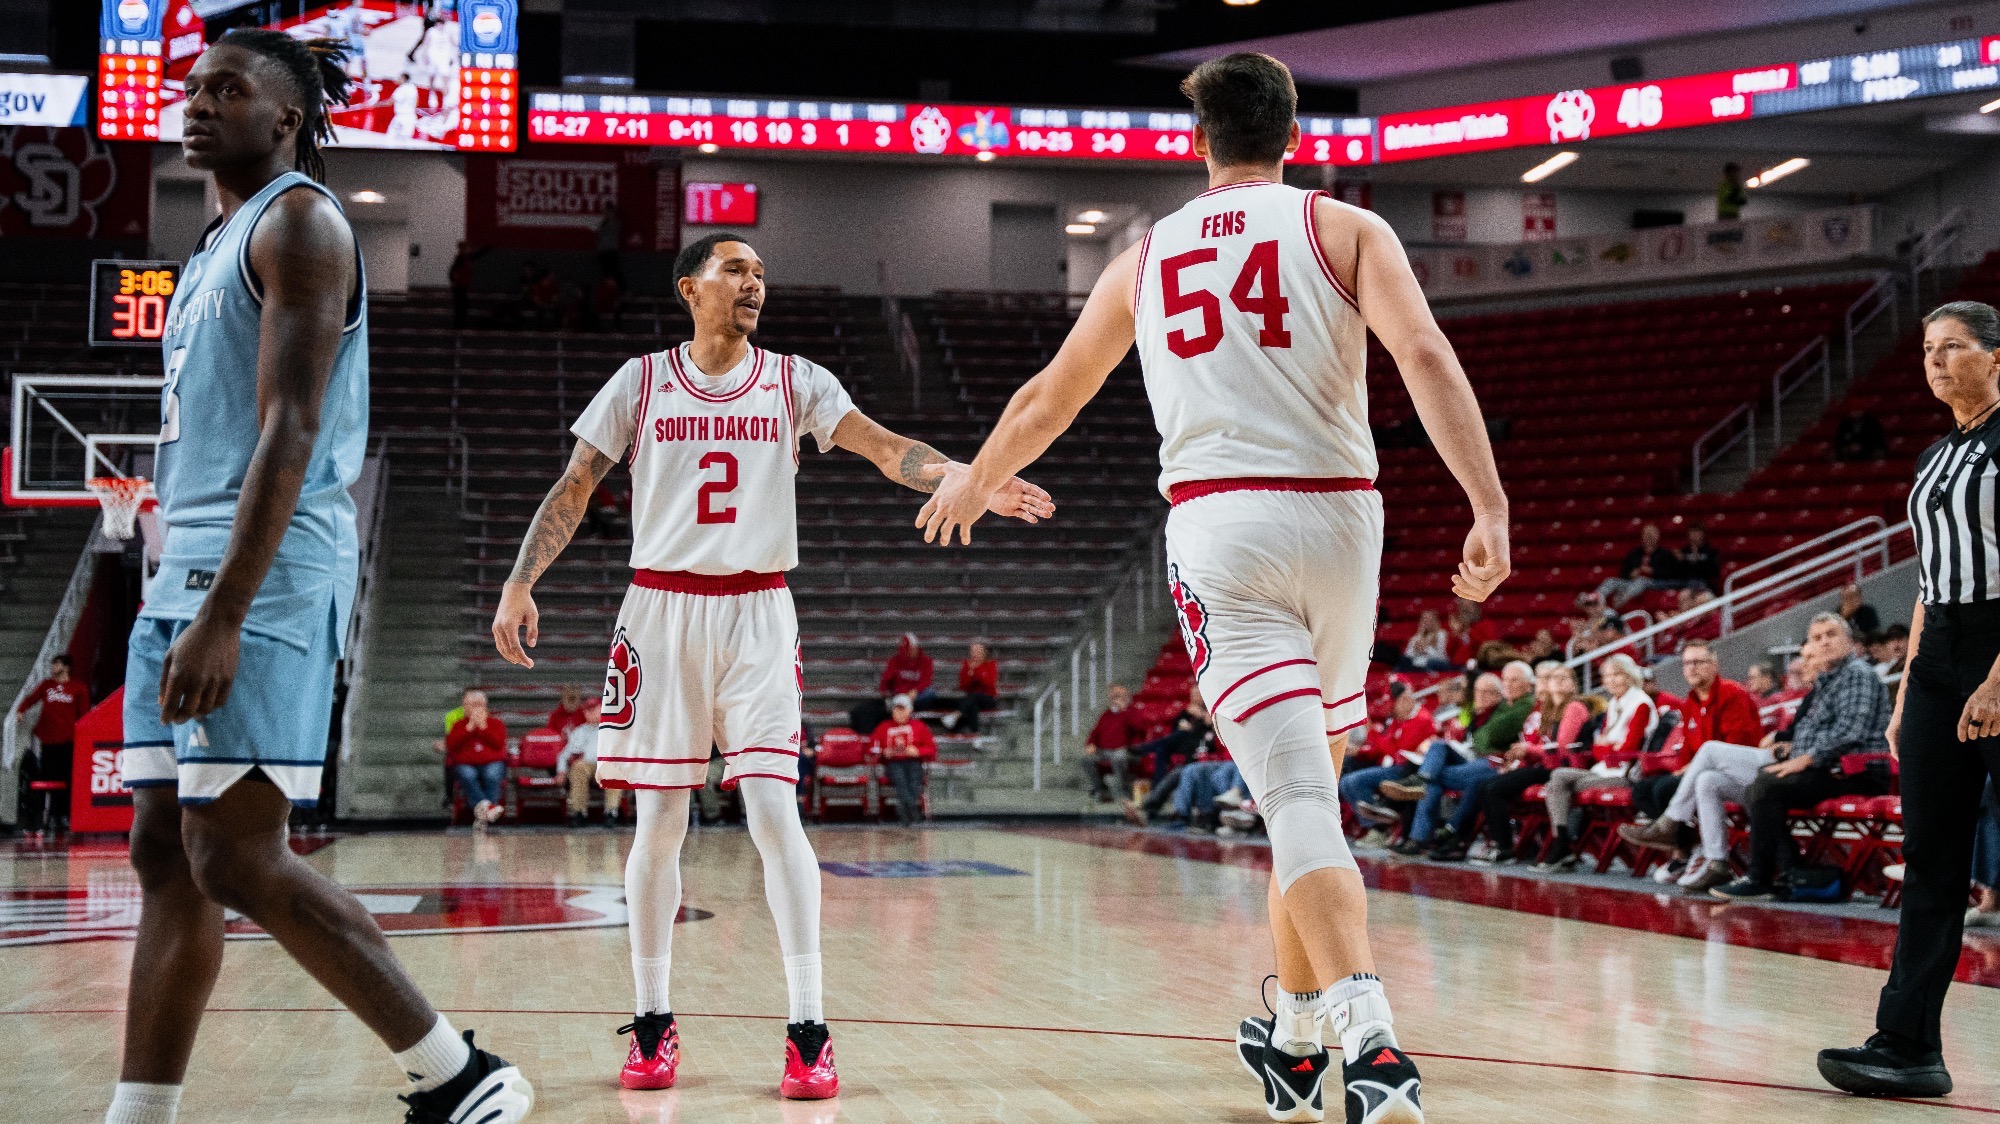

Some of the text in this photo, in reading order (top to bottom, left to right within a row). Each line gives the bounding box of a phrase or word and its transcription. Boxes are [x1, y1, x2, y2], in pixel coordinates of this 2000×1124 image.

[1617, 85, 1663, 128] 46
[604, 117, 648, 138] 7-11
[730, 121, 759, 143] 16
[765, 122, 793, 144] 10
[801, 123, 817, 145] 3
[836, 124, 849, 146] 1
[875, 125, 891, 147] 3
[1313, 139, 1330, 161] 2
[1346, 139, 1363, 161] 6
[511, 170, 618, 193] SOUTH
[1201, 211, 1246, 239] FENS
[120, 269, 175, 296] 3:06
[1160, 240, 1292, 359] 54
[112, 294, 165, 338] 30
[655, 415, 779, 443] SOUTH DAKOTA
[697, 451, 738, 524] 2
